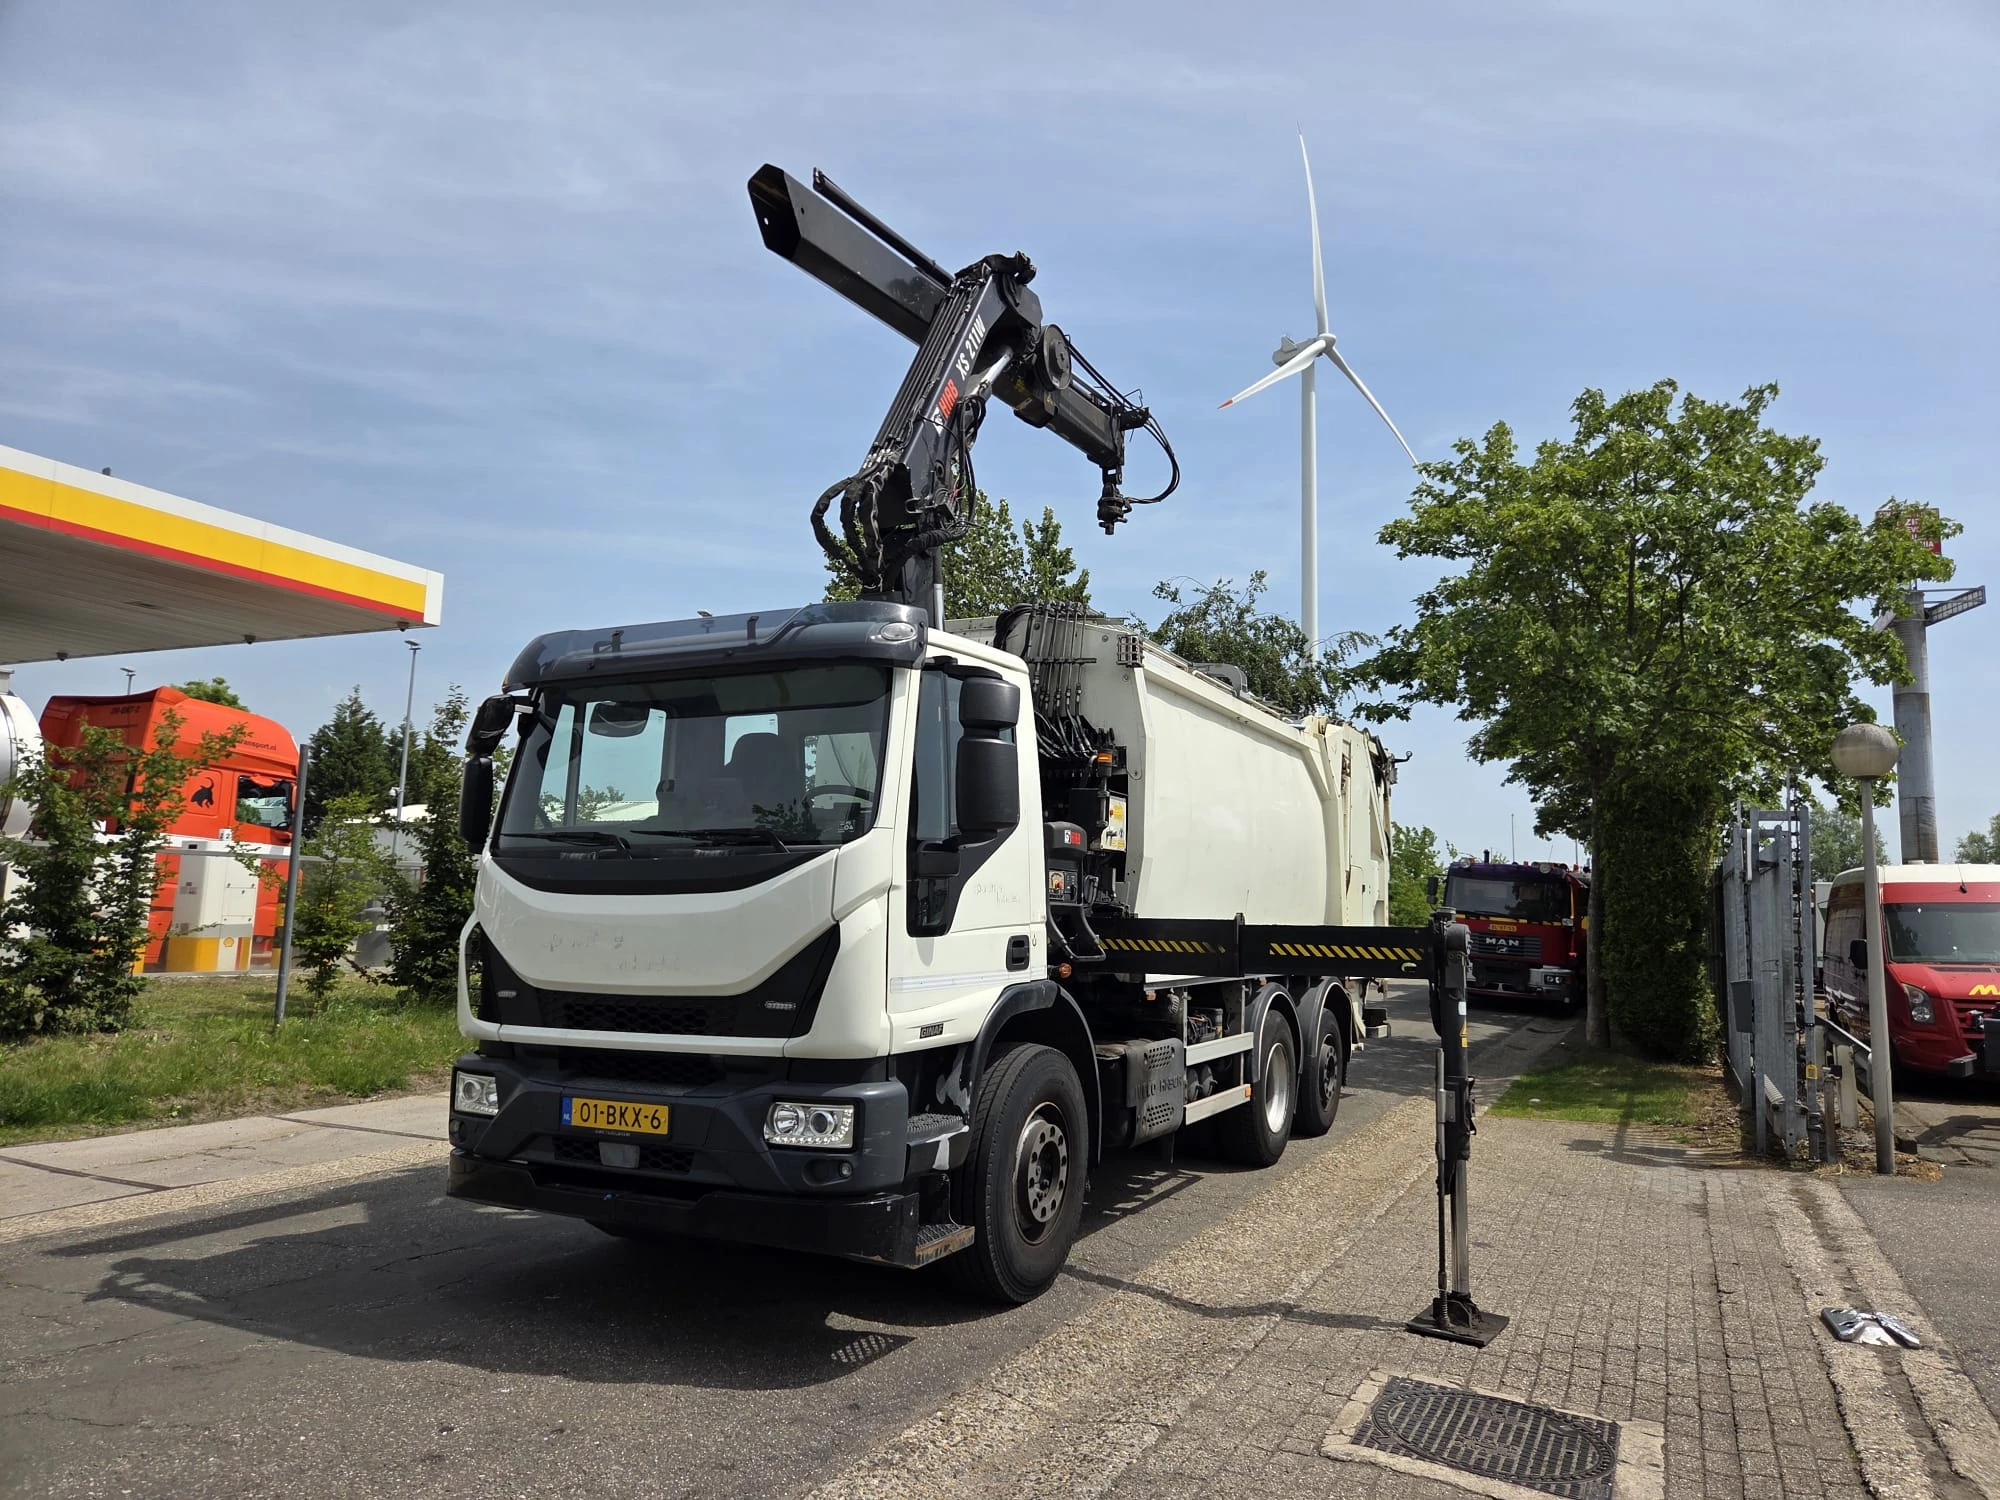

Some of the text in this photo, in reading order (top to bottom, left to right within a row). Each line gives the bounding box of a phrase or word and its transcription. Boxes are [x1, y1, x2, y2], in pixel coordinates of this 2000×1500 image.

[938, 379, 959, 419] HIAB
[956, 353, 970, 381] XS
[238, 738, 277, 751] ransport.nl
[1485, 938, 1519, 946] MAN
[1968, 984, 2000, 996] M
[920, 1025, 943, 1038] GINAF
[580, 1102, 661, 1129] 01-BKX-6
